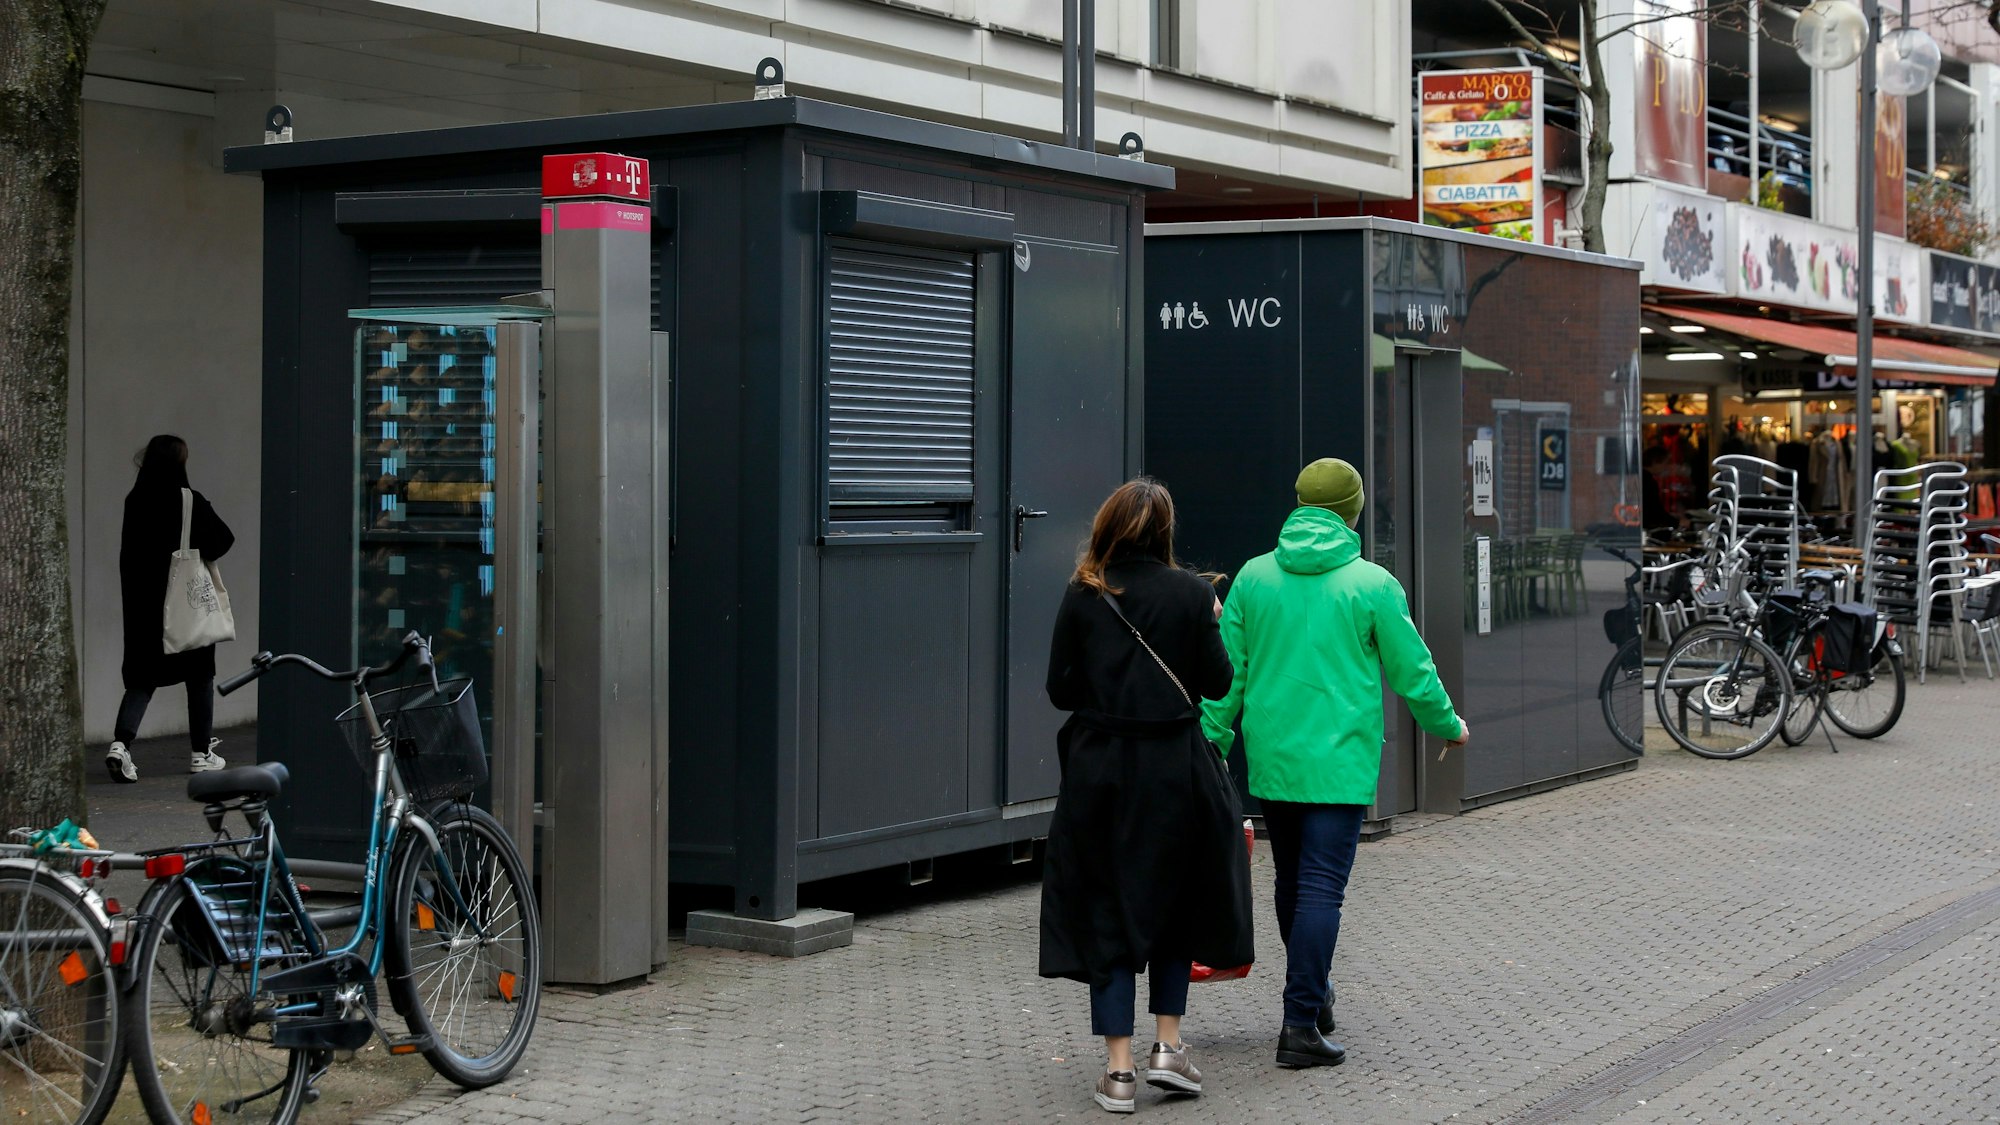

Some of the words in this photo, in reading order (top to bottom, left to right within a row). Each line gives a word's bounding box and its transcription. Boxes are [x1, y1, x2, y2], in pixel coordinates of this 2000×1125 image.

[1463, 74, 1526, 90] MARCO
[1447, 91, 1456, 99] &
[1457, 90, 1484, 99] Gelato
[1485, 83, 1531, 101] POLO
[1454, 123, 1503, 138] PIZZA
[625, 160, 641, 195] T
[1437, 185, 1520, 202] CIABATTA
[623, 211, 644, 221] HOTSPOT
[1227, 297, 1282, 328] WC
[1430, 305, 1449, 334] WC
